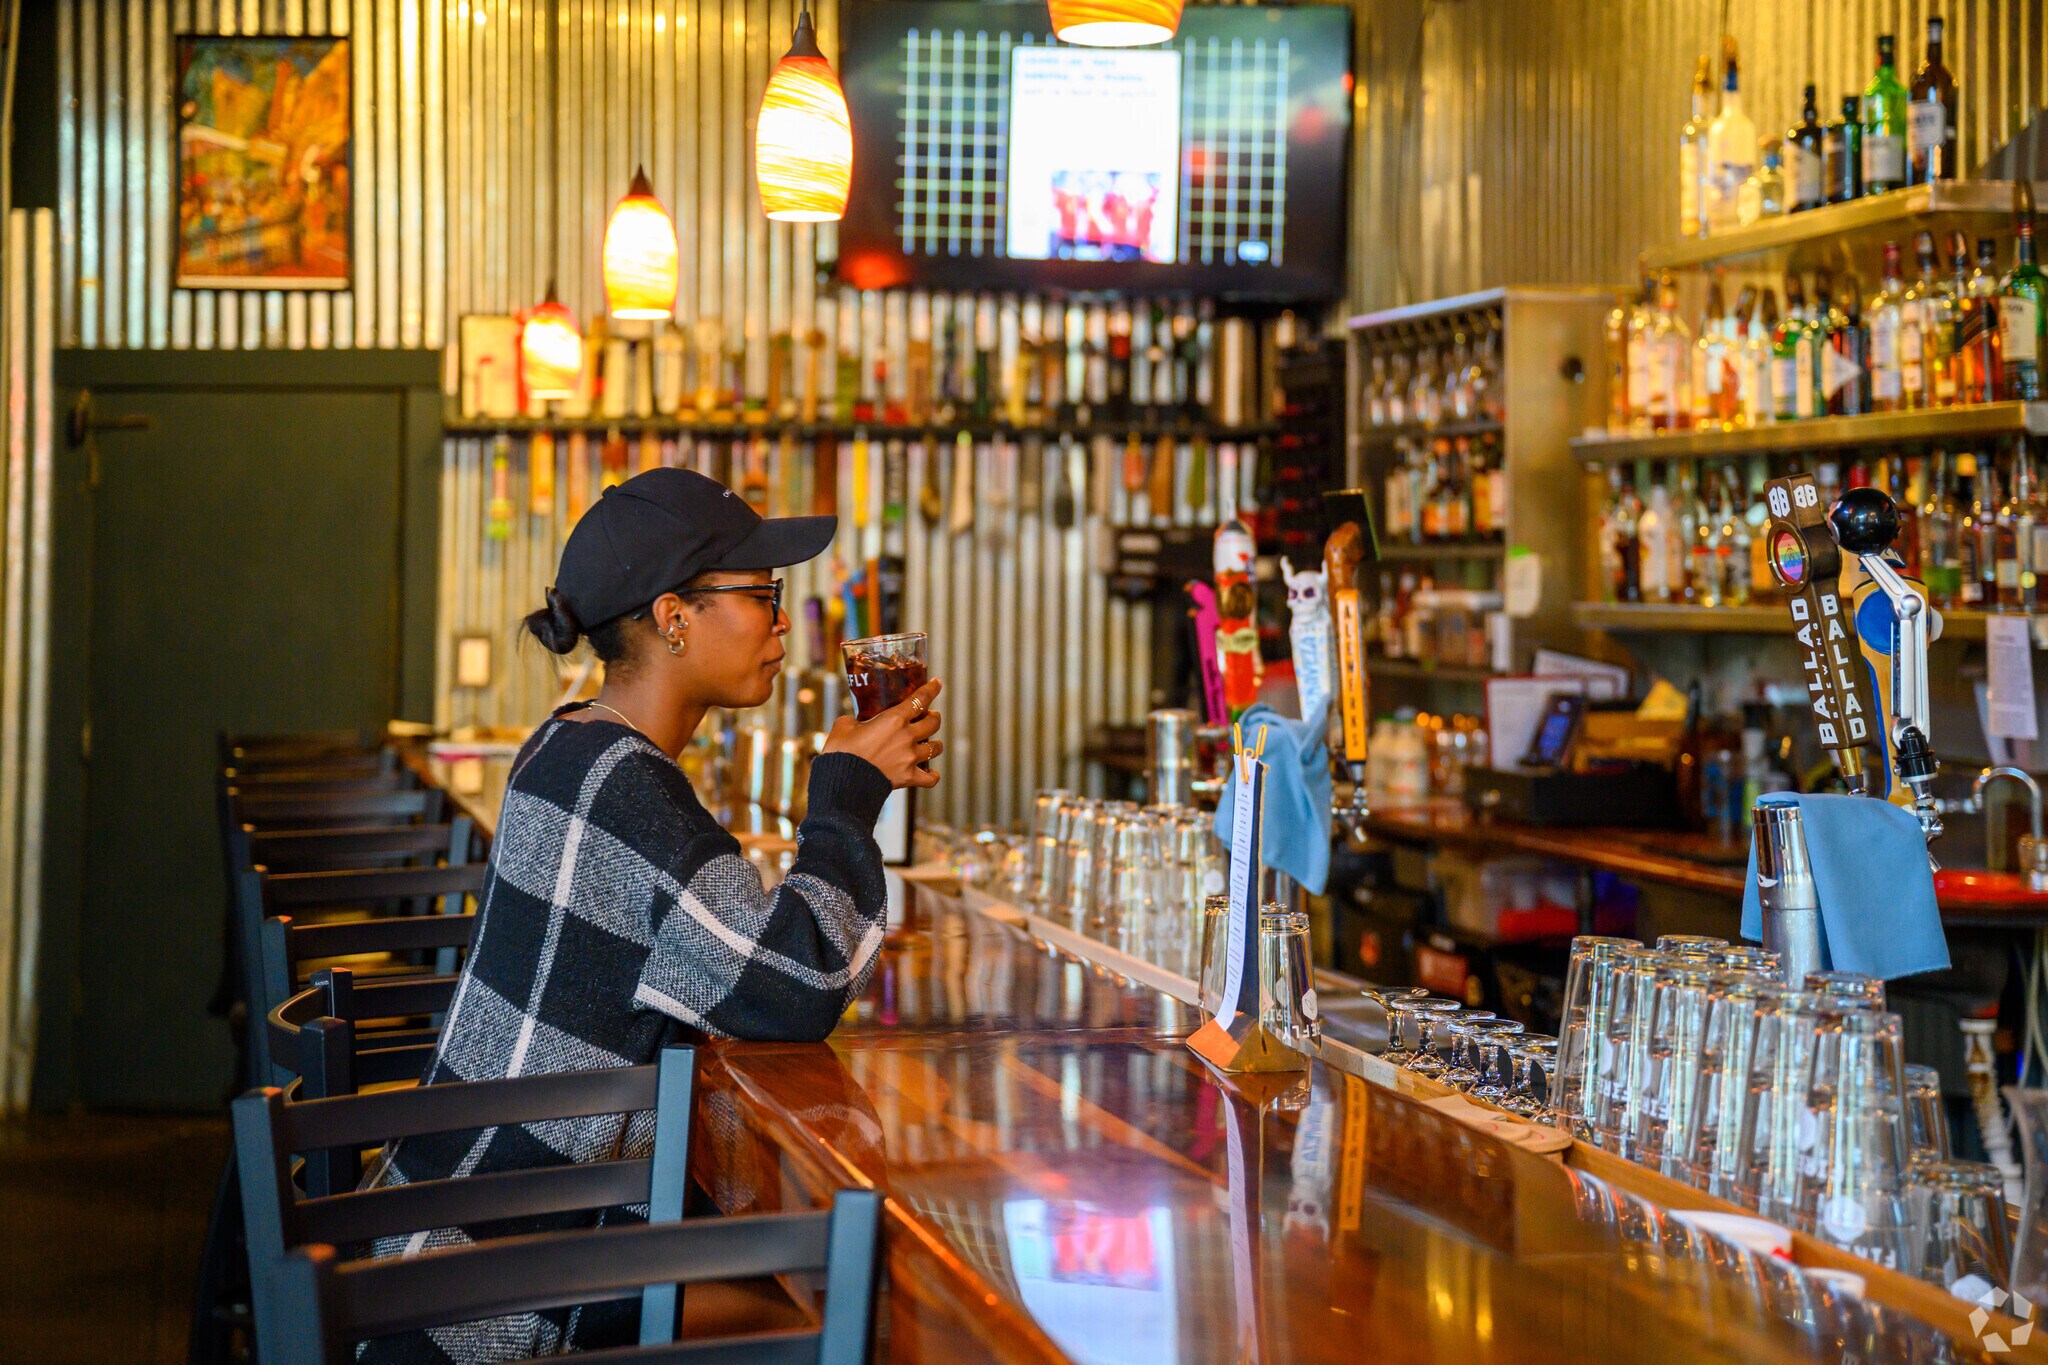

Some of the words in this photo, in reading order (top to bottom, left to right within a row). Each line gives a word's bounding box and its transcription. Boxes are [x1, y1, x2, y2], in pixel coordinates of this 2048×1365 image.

[1791, 598, 1839, 744] BALLAD
[1812, 622, 1839, 719] BREWING
[1820, 594, 1867, 739] BALLAD
